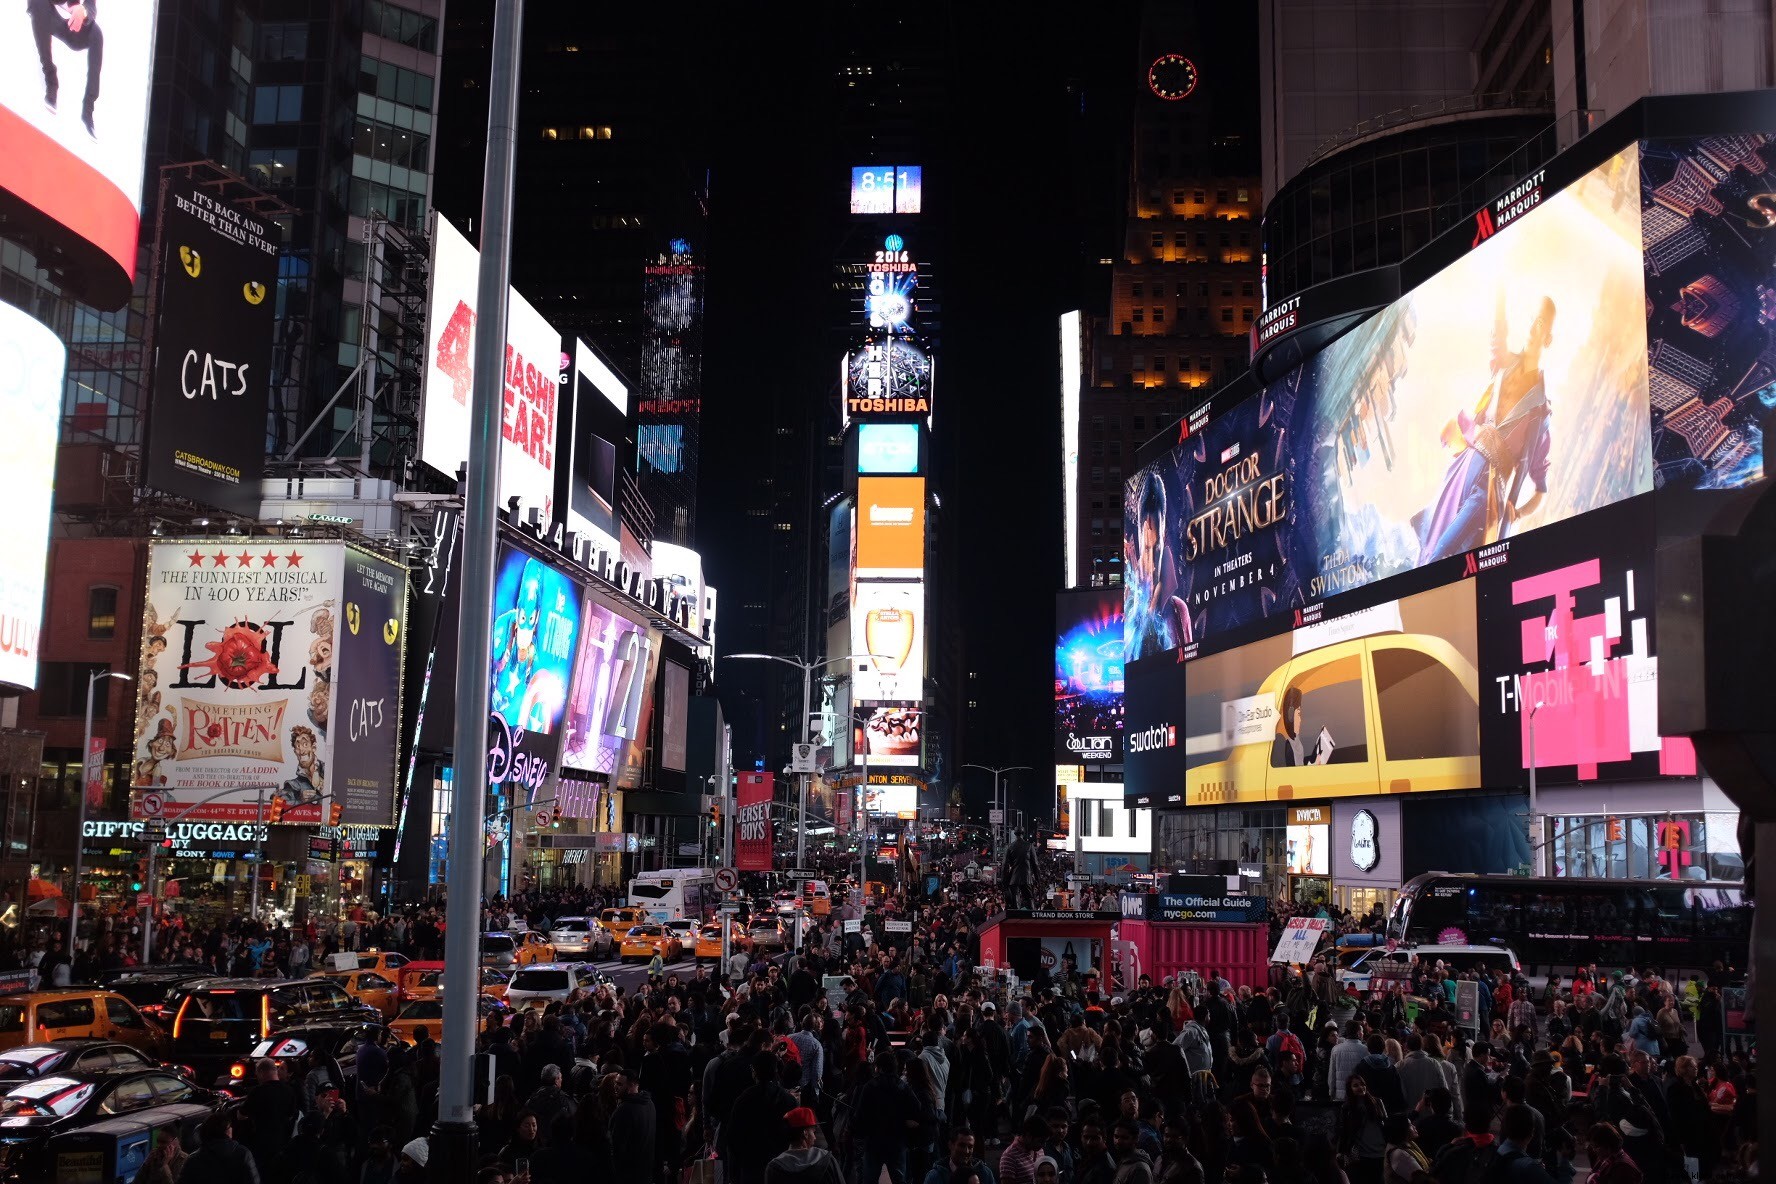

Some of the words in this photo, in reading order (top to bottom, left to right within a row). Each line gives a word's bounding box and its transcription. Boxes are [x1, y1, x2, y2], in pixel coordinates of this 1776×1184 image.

[861, 171, 908, 192] 8:51
[1497, 169, 1547, 212] MARRIOTT
[193, 191, 213, 209] IT'S
[214, 202, 241, 225] BACK
[242, 218, 264, 236] AND
[1497, 191, 1542, 228] MARQUIS
[218, 217, 247, 241] THAN
[875, 250, 909, 263] 2016
[866, 263, 917, 272] TOSHIBA
[1260, 296, 1301, 327] MARRIOTT
[1260, 314, 1296, 343] MARQUIS
[181, 350, 249, 400] CATS
[848, 398, 929, 412] TOSHIBA
[1189, 402, 1211, 422] MARRIOTT
[1189, 414, 1210, 434] MARQUIS
[1204, 452, 1261, 505] DOCTOR
[311, 514, 350, 524] LAMAR
[1186, 473, 1286, 561] STRANGE
[1478, 542, 1510, 558] MARRIOTT
[356, 563, 365, 575] LET
[366, 567, 375, 578] THE
[1214, 566, 1222, 578] IN
[1222, 552, 1252, 574] THEATERS
[1323, 553, 1350, 572] TILDA
[1478, 554, 1508, 570] MARQUIS
[161, 571, 188, 584] THE
[192, 571, 262, 584] FUNNIEST
[265, 571, 328, 584] MUSICAL
[1195, 569, 1263, 605] NOVEMBER
[1269, 564, 1275, 577] 4
[1310, 565, 1363, 597] SWINTON
[184, 586, 205, 600] IN
[208, 588, 240, 601] 400
[1302, 602, 1324, 614] MARRIOTT
[1302, 612, 1322, 623] MARQUIS
[606, 631, 651, 741] 21
[196, 704, 272, 715] SOMETHING
[350, 698, 385, 743] CATS
[1130, 724, 1168, 753] swatch
[204, 766, 231, 774] DIRECTOR
[240, 766, 279, 774] ALADDIN
[176, 780, 195, 788] THE
[197, 780, 221, 788] BOOK
[223, 780, 235, 788] OF
[237, 780, 278, 788] MORMON
[554, 777, 600, 819] FOREVER
[736, 802, 772, 824] JERSEY
[82, 821, 145, 838] GIFTS
[166, 823, 267, 841] LUGGAGE
[347, 826, 380, 841] LUGGAGE
[741, 821, 766, 841] BOYS
[171, 839, 191, 849] NY
[175, 850, 206, 858] SONY
[212, 851, 235, 859] BOWER
[562, 850, 582, 864] FOREVER
[803, 870, 814, 878] WAY
[1127, 896, 1143, 915] NYC
[1164, 897, 1181, 907] The
[1184, 896, 1220, 908] Official
[1222, 898, 1252, 908] Guide
[1031, 911, 1055, 919] STRAND
[1056, 911, 1073, 919] BOOK
[1074, 911, 1095, 920] STORE
[1164, 909, 1216, 920] nycgo.com
[1292, 929, 1308, 941] ALL
